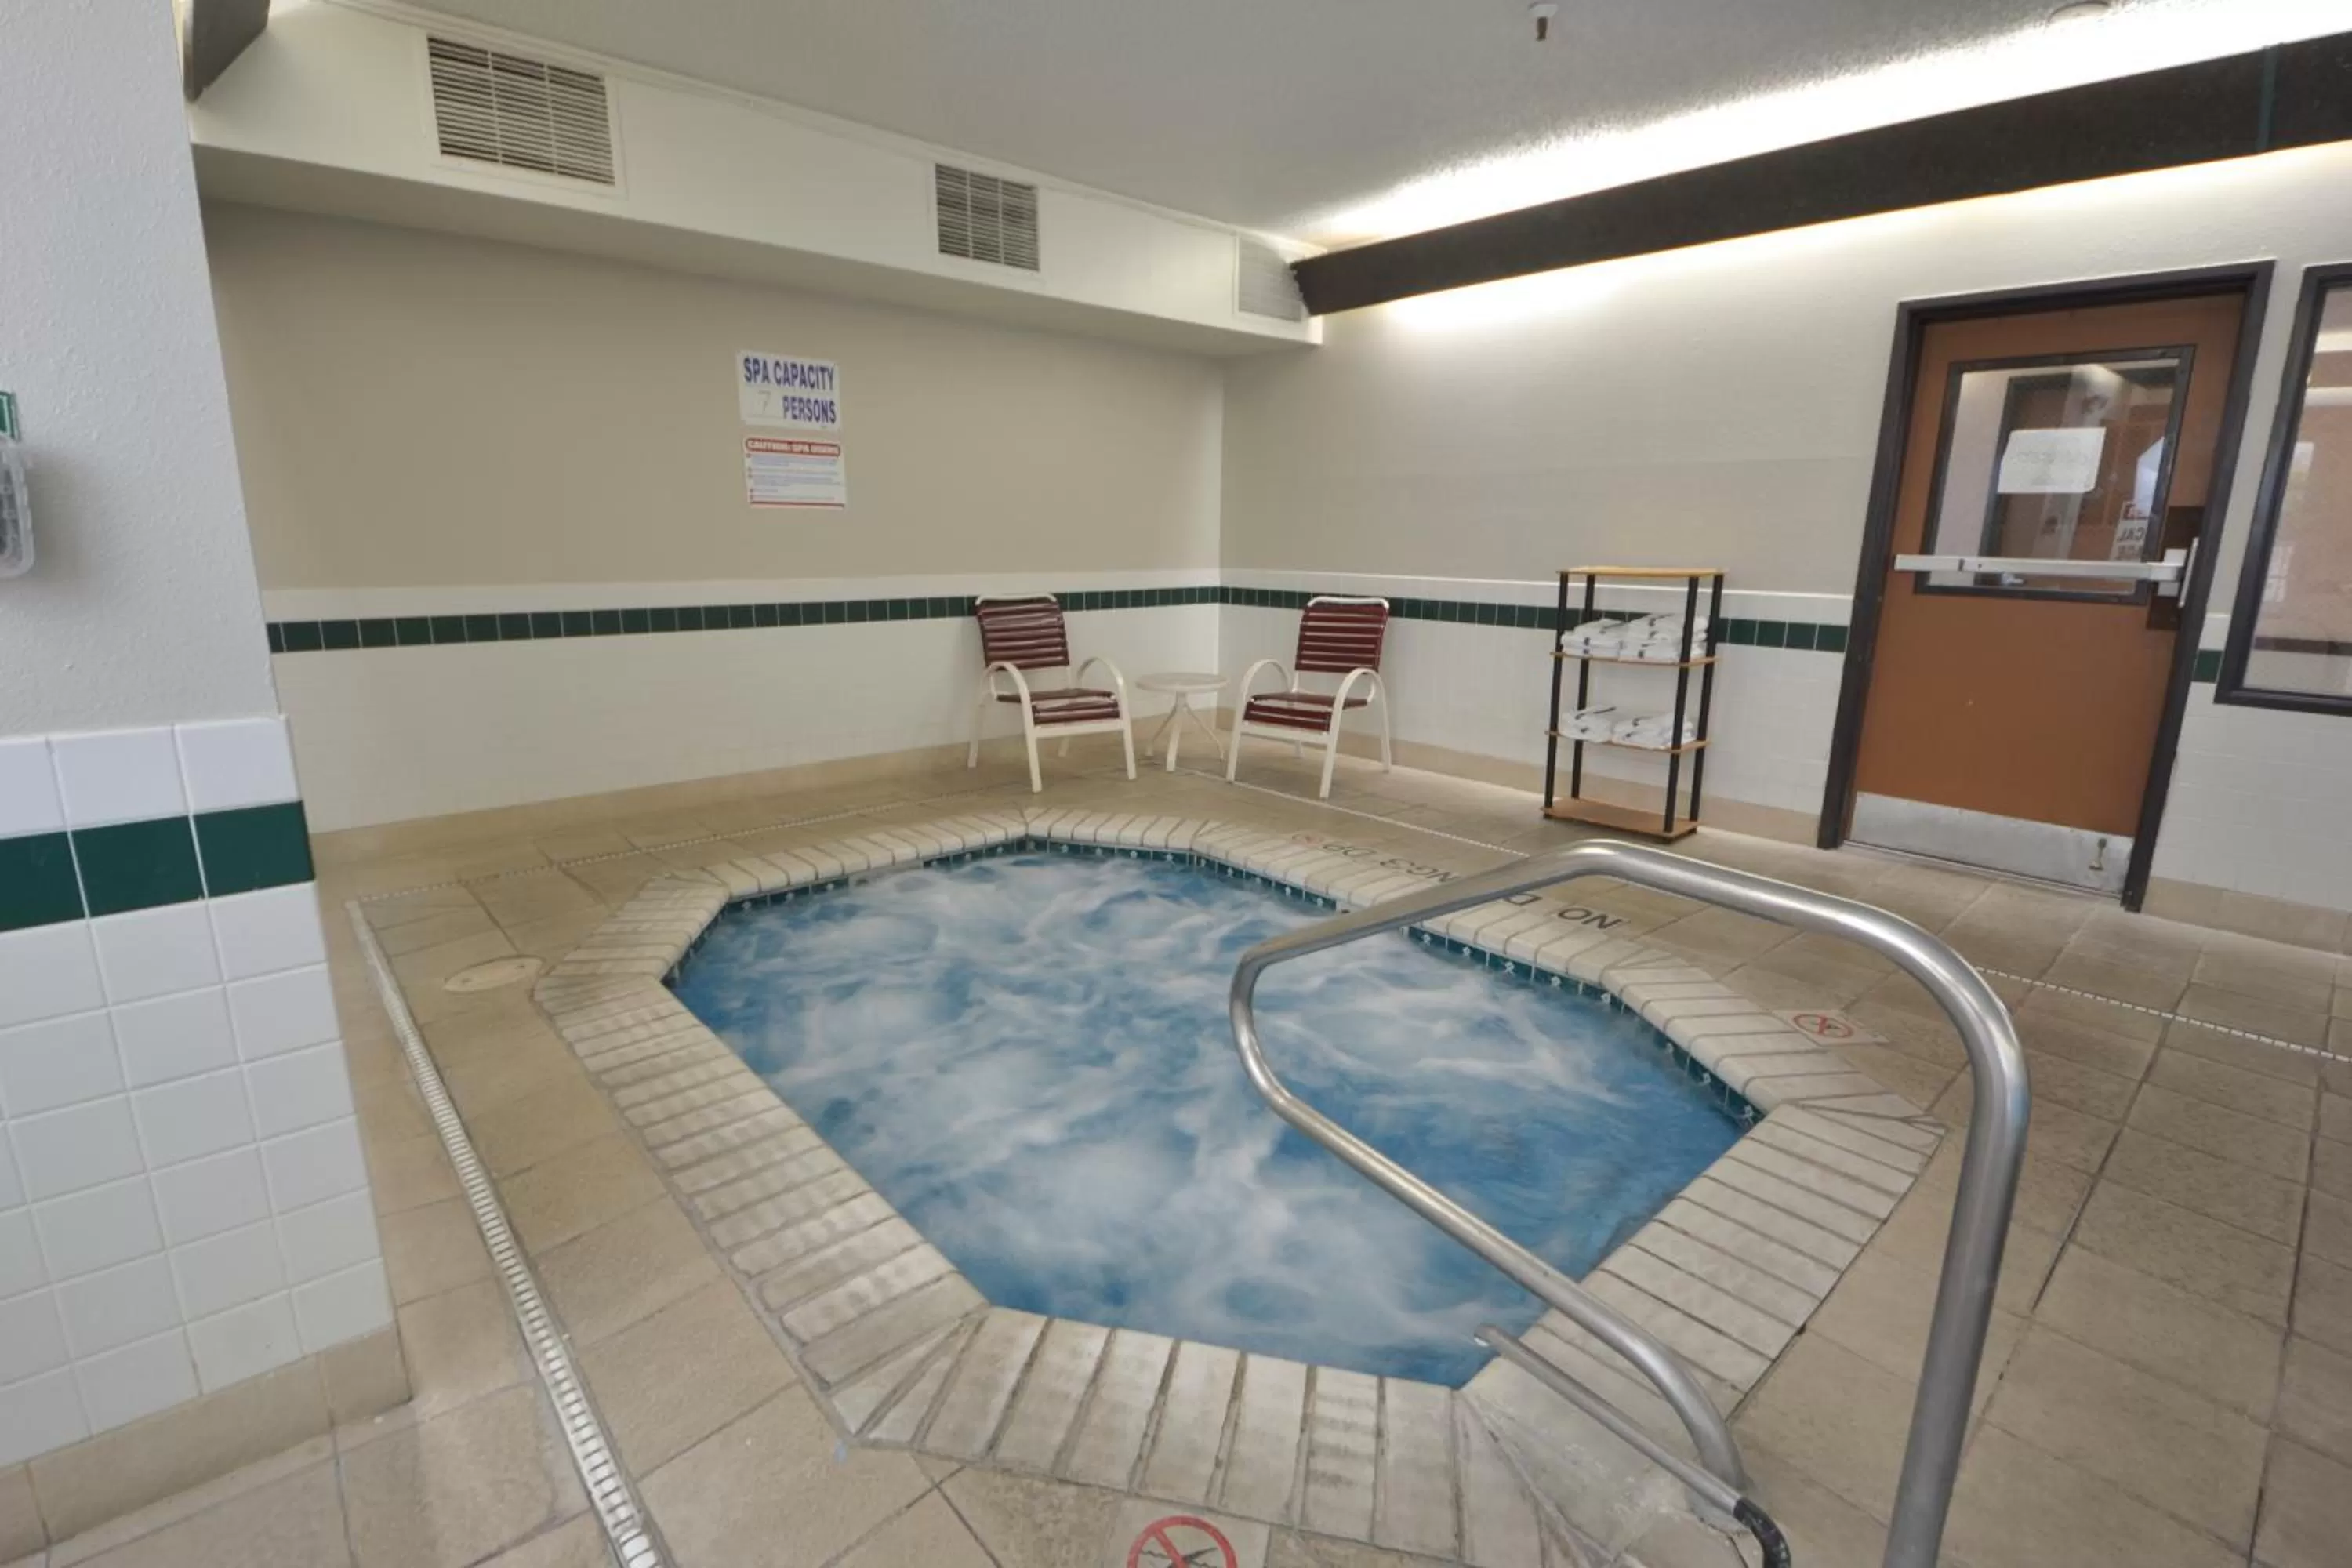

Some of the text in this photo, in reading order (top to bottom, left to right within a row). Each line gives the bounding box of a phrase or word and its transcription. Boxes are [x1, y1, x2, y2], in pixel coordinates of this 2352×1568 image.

[743, 357, 834, 390] SPA CAPACITY
[782, 395, 837, 424] PERSONS
[1557, 907, 1623, 929] NO
